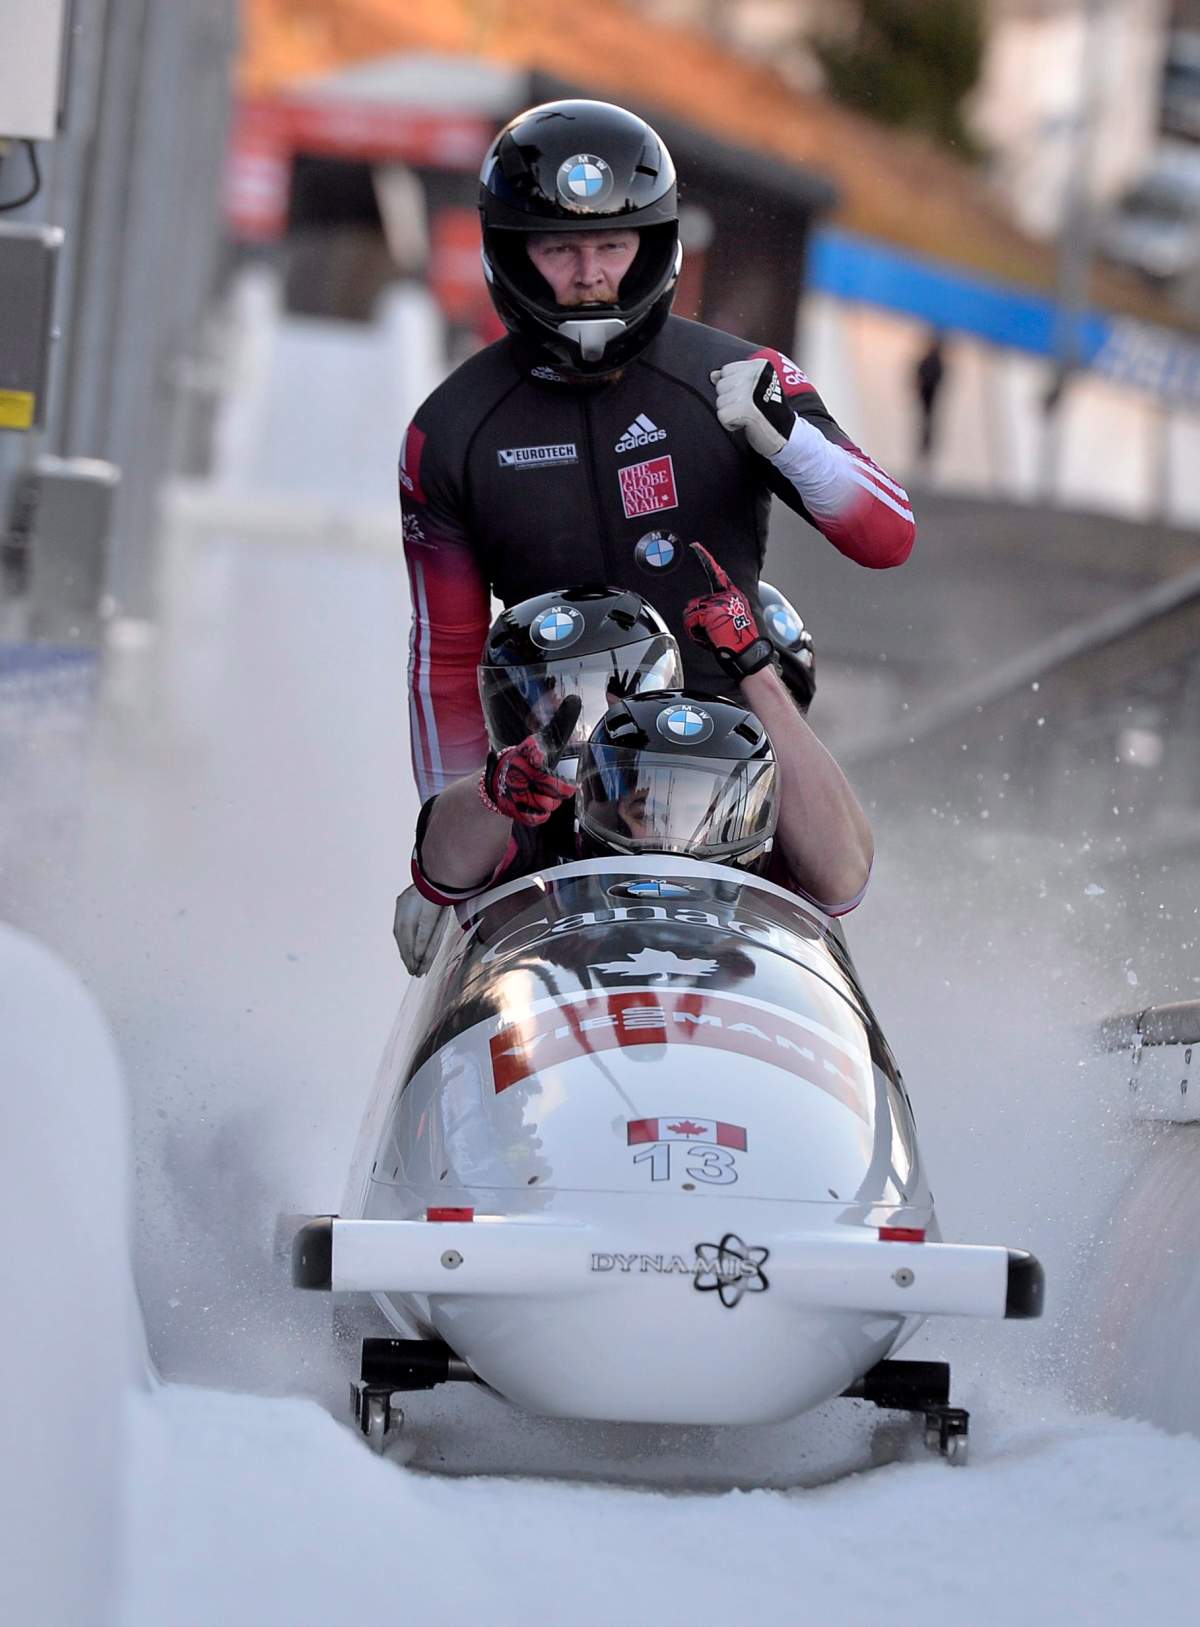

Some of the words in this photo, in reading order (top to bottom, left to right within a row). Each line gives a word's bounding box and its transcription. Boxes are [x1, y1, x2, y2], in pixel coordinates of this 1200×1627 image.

[615, 429, 667, 453] adidas
[516, 446, 574, 461] EUROTECH
[620, 463, 651, 482] THE
[624, 470, 669, 493] GLOBE
[625, 486, 655, 504] AND
[626, 496, 664, 515] MAIL
[480, 904, 790, 963] Canad
[633, 1143, 738, 1185] 13
[591, 1253, 759, 1278] DYNAMIS
